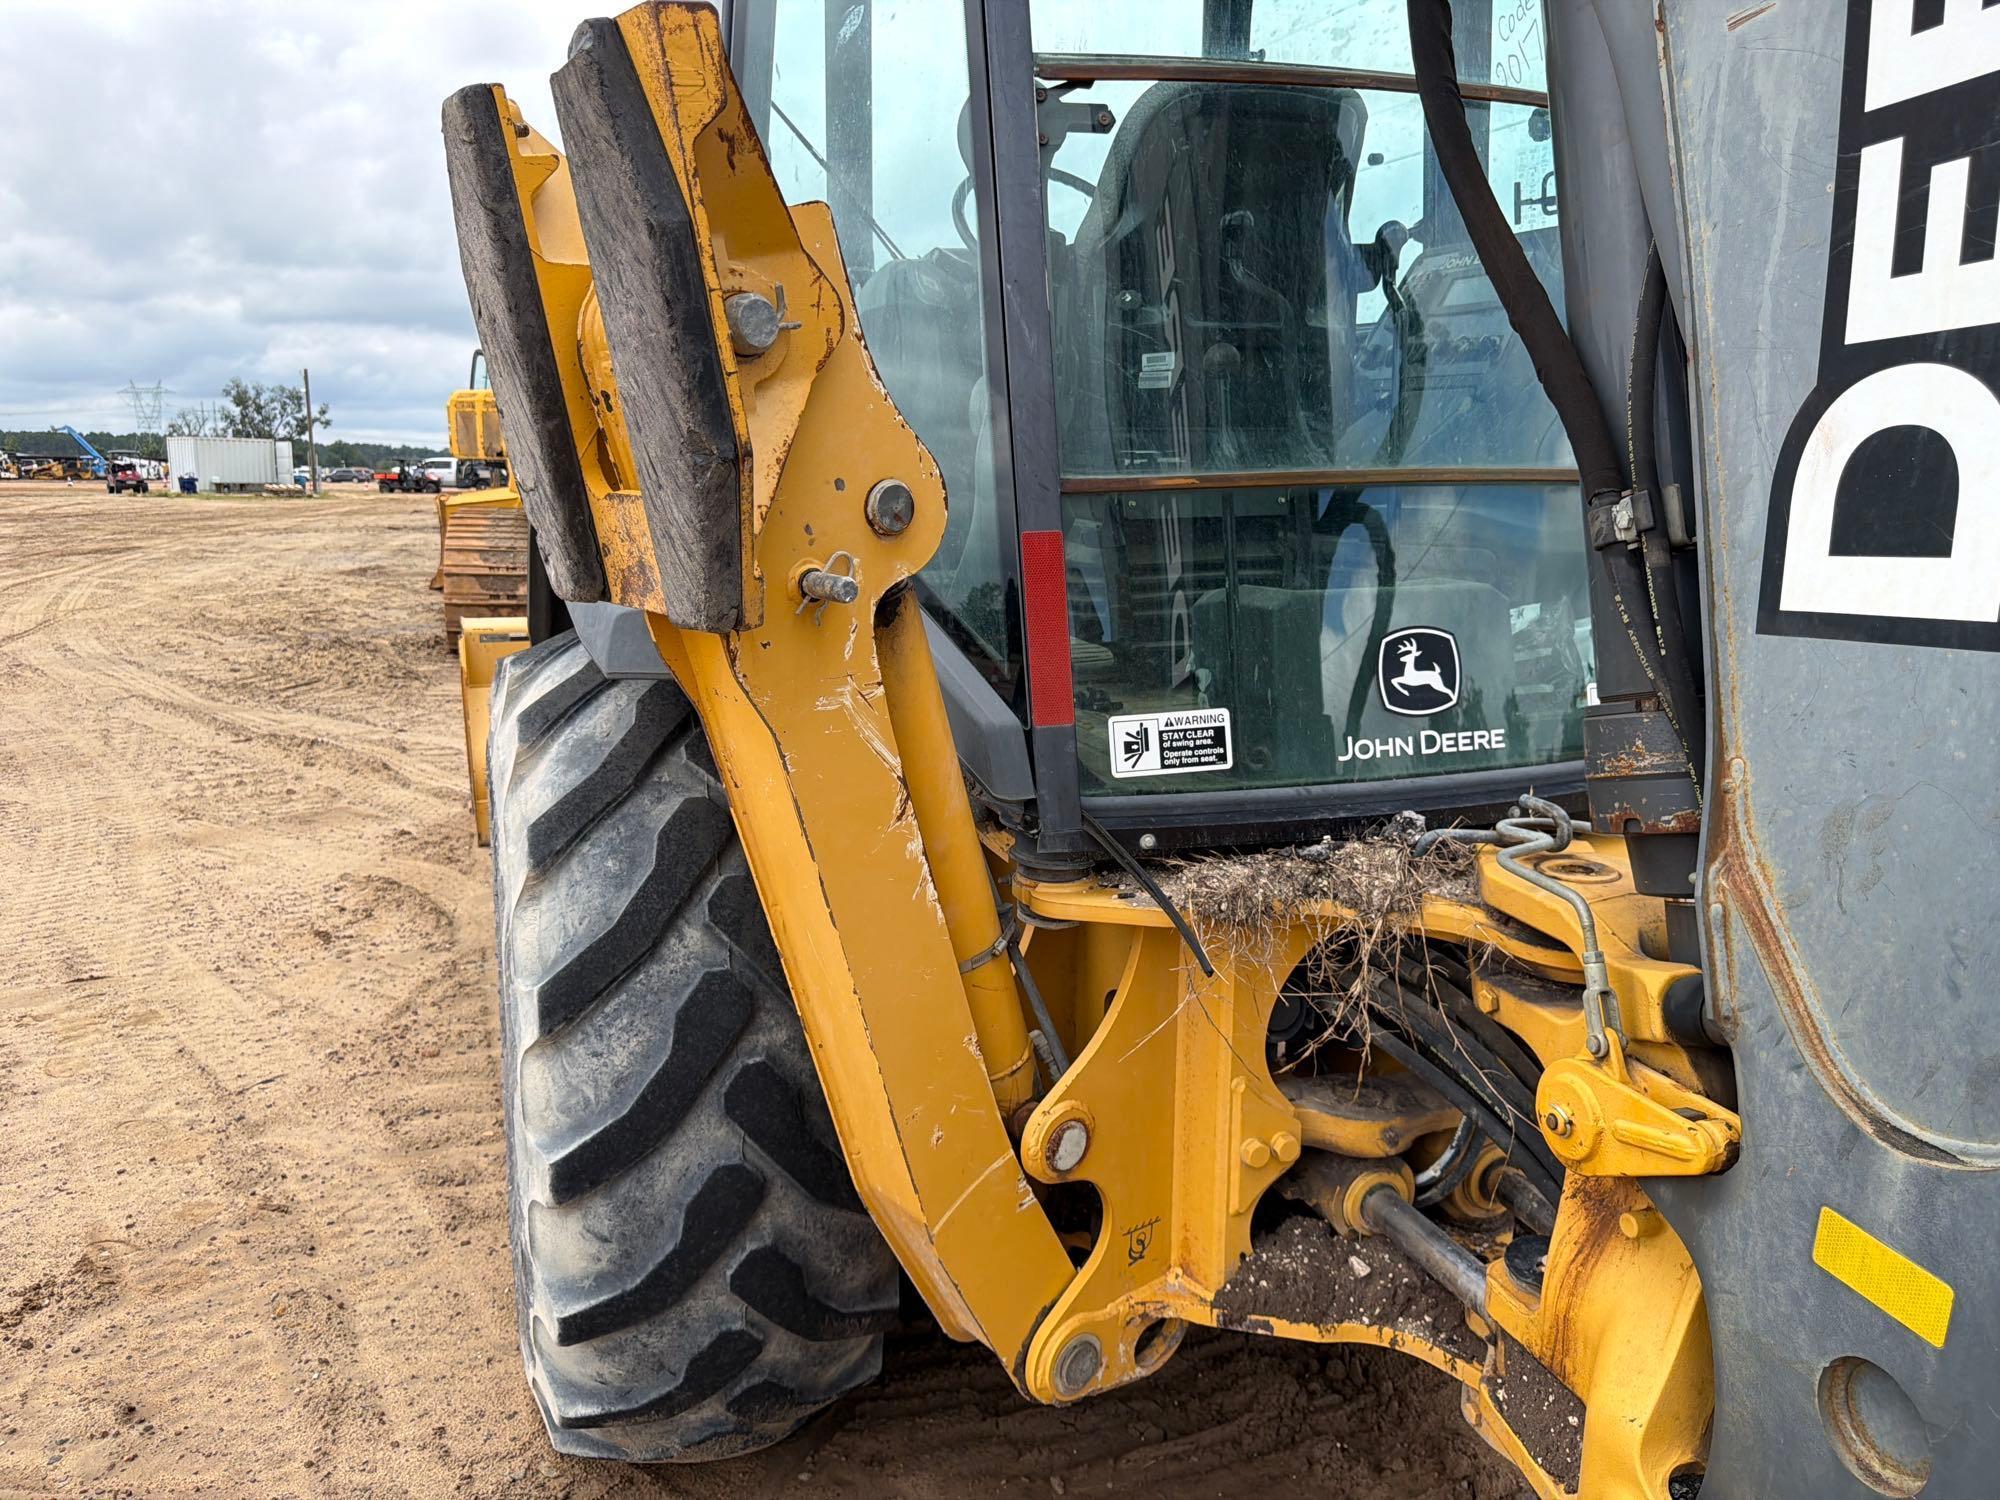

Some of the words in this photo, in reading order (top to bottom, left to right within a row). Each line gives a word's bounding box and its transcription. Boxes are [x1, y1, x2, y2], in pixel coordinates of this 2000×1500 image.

[1627, 629, 1655, 680] AEROQUIP
[1174, 714, 1225, 726] WARNING
[1162, 732, 1184, 741] STAY
[1186, 729, 1214, 739] CLEAR
[1172, 739, 1194, 748] swing
[1337, 736, 1414, 762] JOHN
[1420, 728, 1506, 755] DEERE
[1163, 749, 1192, 759] Operate
[1194, 747, 1224, 756] controls
[1164, 758, 1180, 767] only
[1182, 756, 1199, 764] from
